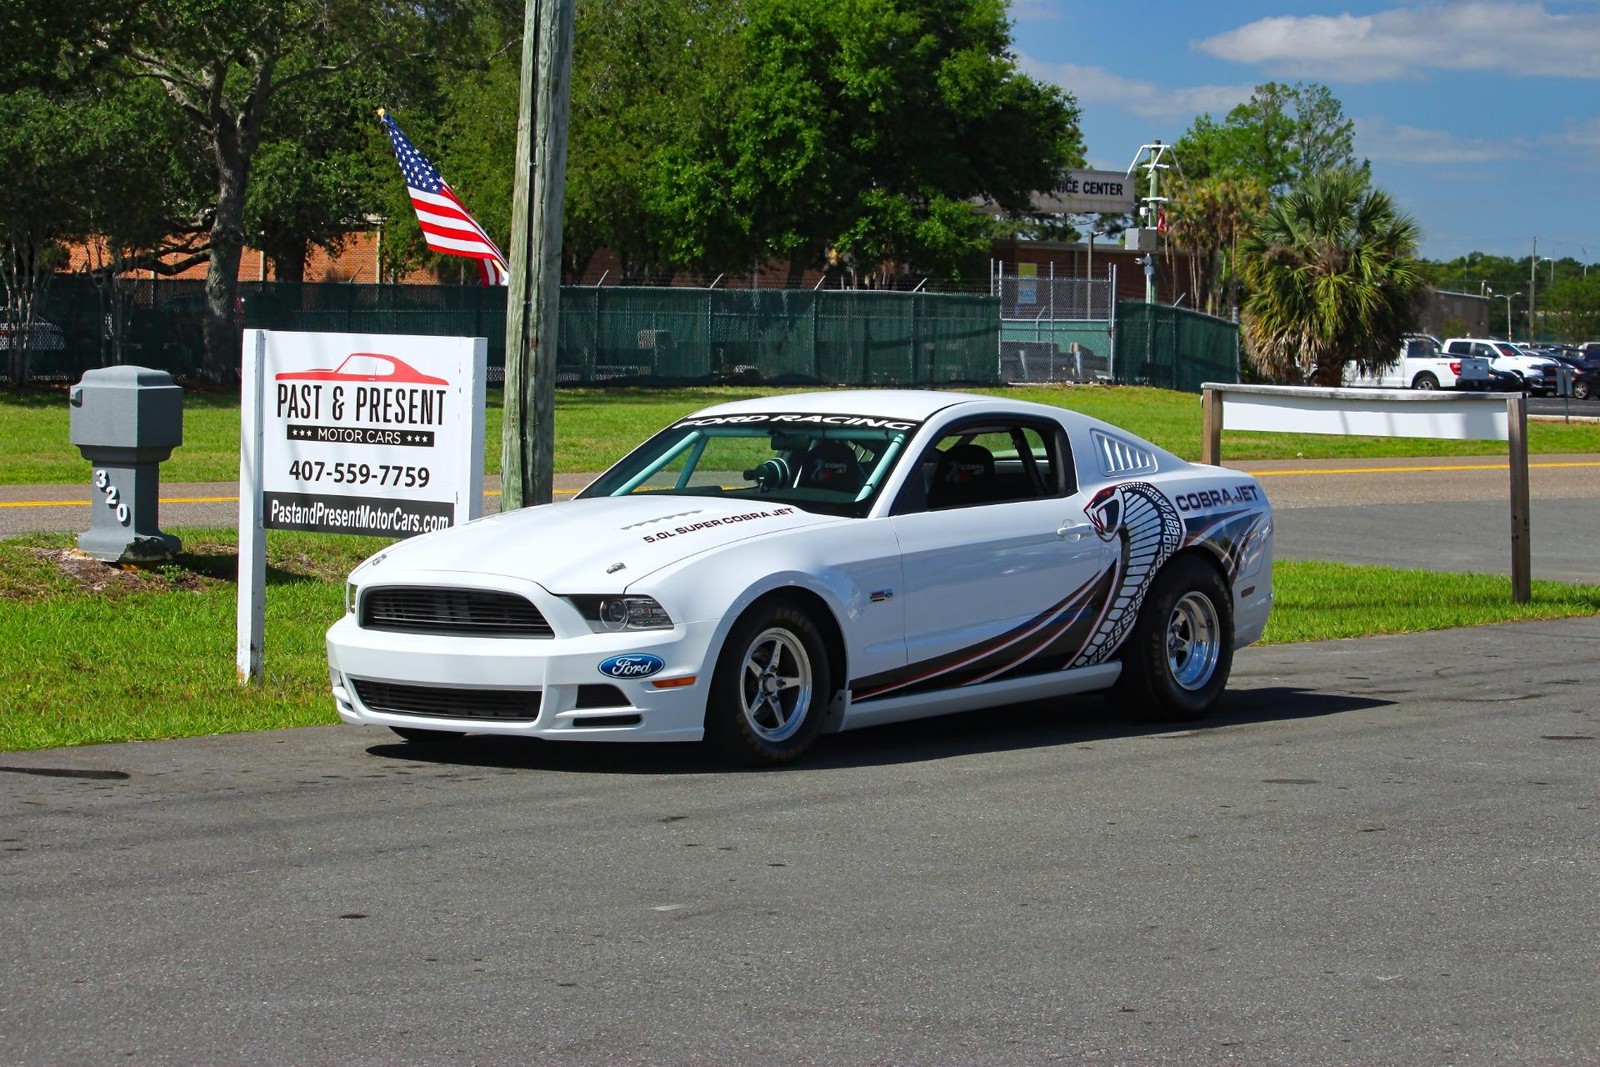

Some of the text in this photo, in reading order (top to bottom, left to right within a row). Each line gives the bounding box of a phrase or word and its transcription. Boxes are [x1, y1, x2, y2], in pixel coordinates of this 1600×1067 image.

[1083, 181, 1124, 196] CENTER
[277, 383, 446, 425] PAST & PRESENT
[672, 414, 917, 430] FORD RACING
[317, 427, 401, 445] MOTOR CARS
[289, 460, 430, 488] 407-559-7759
[95, 469, 128, 522] 320
[1175, 484, 1259, 511] COBRA JET
[271, 499, 449, 533] PastandPresentMotorCars.com
[643, 507, 796, 544] 5.0L SUPER COBRA JET
[611, 657, 652, 676] Ford
